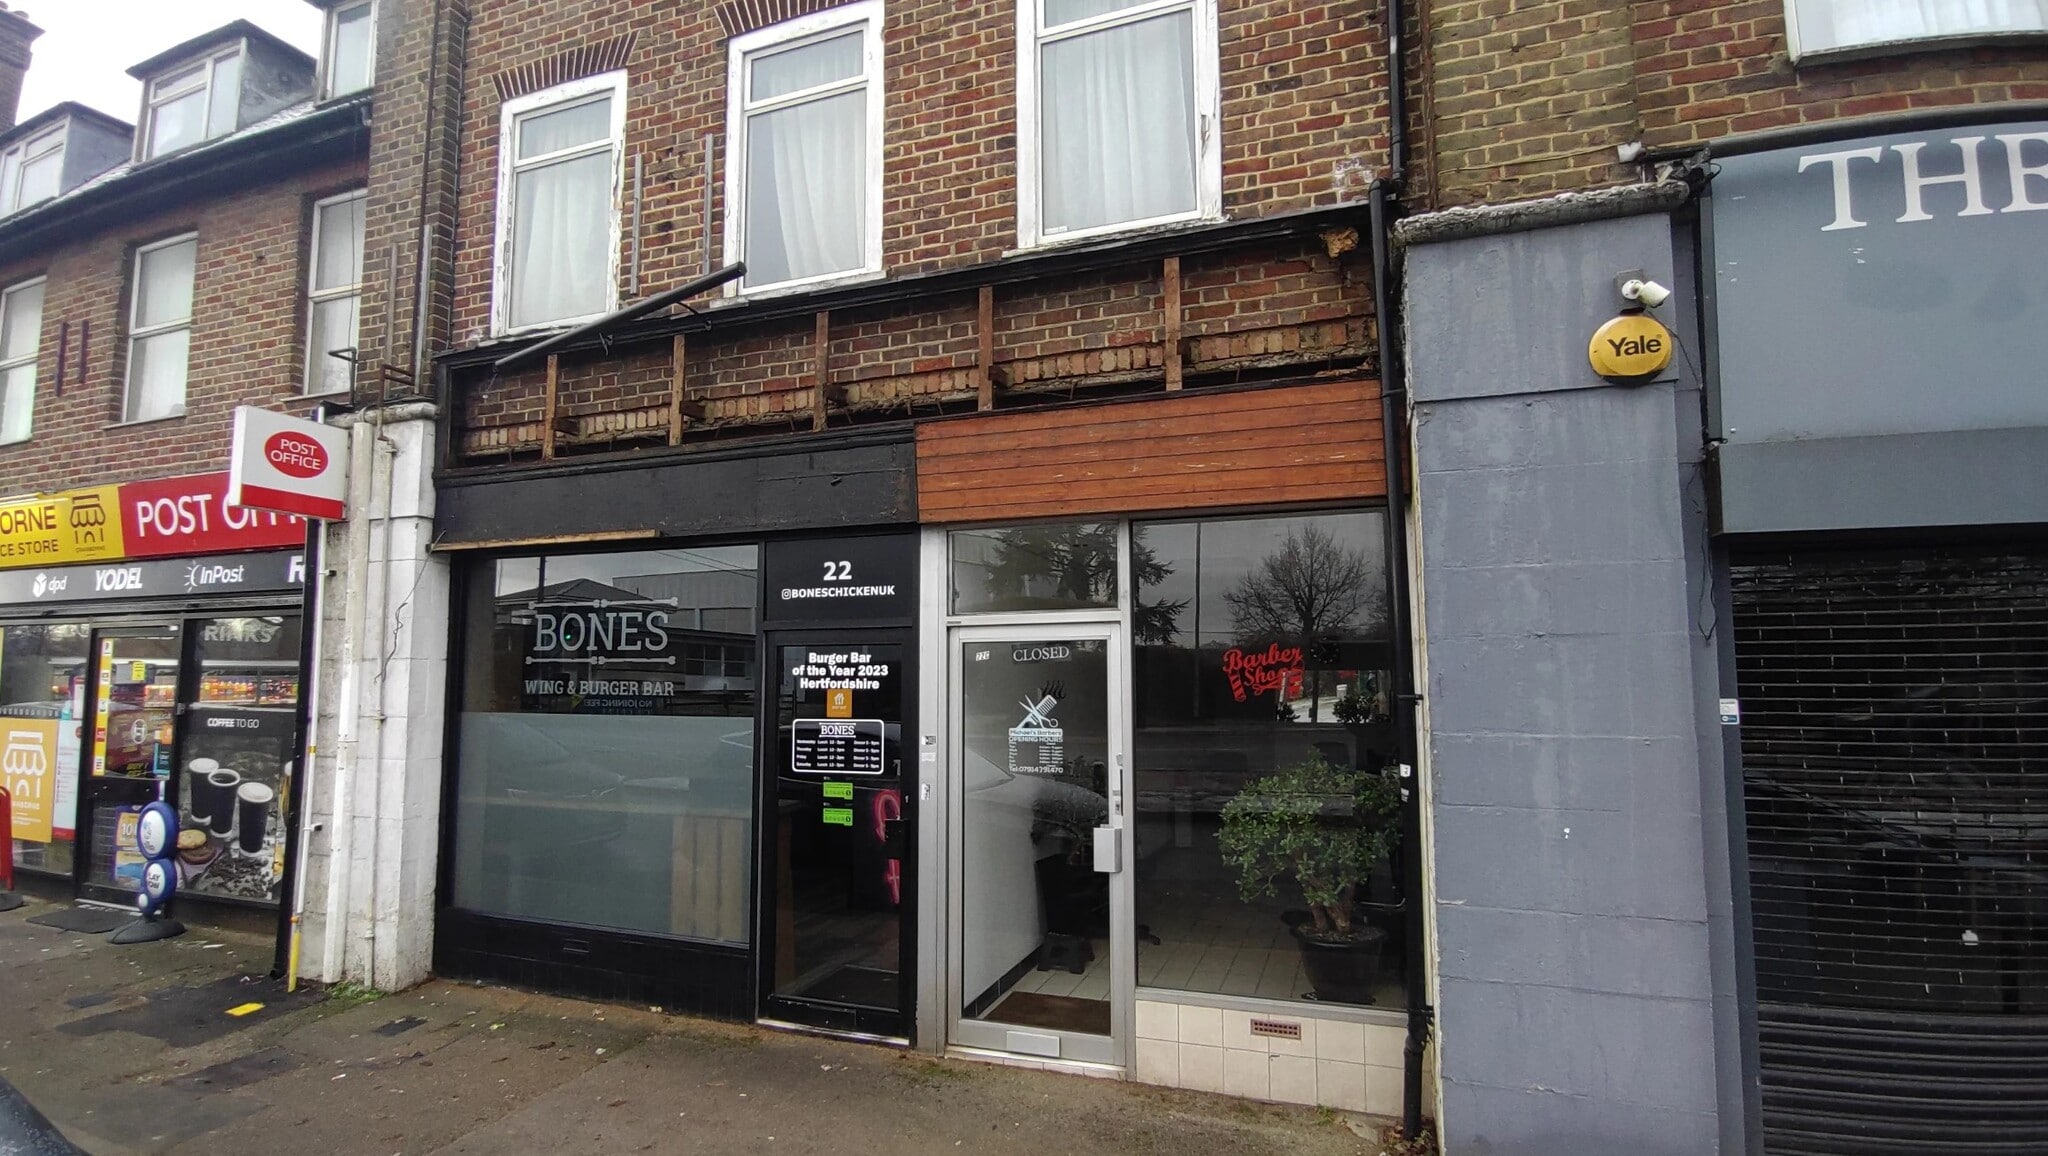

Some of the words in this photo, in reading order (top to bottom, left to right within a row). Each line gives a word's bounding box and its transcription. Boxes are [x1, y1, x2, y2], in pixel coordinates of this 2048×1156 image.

[1798, 131, 2048, 232] THE
[1606, 335, 1662, 357] Yale
[280, 438, 318, 456] POST
[270, 450, 321, 471] OFFICE
[0, 505, 57, 535] ORNE
[136, 494, 212, 537] POST
[18, 539, 59, 556] STORE
[95, 567, 143, 591] YODEL
[200, 564, 244, 585] InPost
[823, 561, 852, 581] 22
[48, 575, 68, 594] dpd
[533, 611, 669, 651] BONES
[808, 652, 848, 665] Burger
[850, 652, 871, 663] Bar
[1013, 646, 1070, 662] CLOSED
[1222, 642, 1303, 673] Barber
[792, 665, 805, 676] of
[807, 665, 826, 676] the
[829, 665, 855, 676] Year
[858, 665, 888, 676] 2023
[524, 680, 564, 695] WING
[567, 680, 577, 695] &
[579, 681, 639, 696] BURGER
[642, 681, 674, 696] BAR
[800, 678, 880, 690] Hertfordshire
[207, 718, 235, 728] COFFEE
[236, 718, 246, 728] TO
[247, 719, 259, 728] GO
[820, 725, 855, 735] BONES
